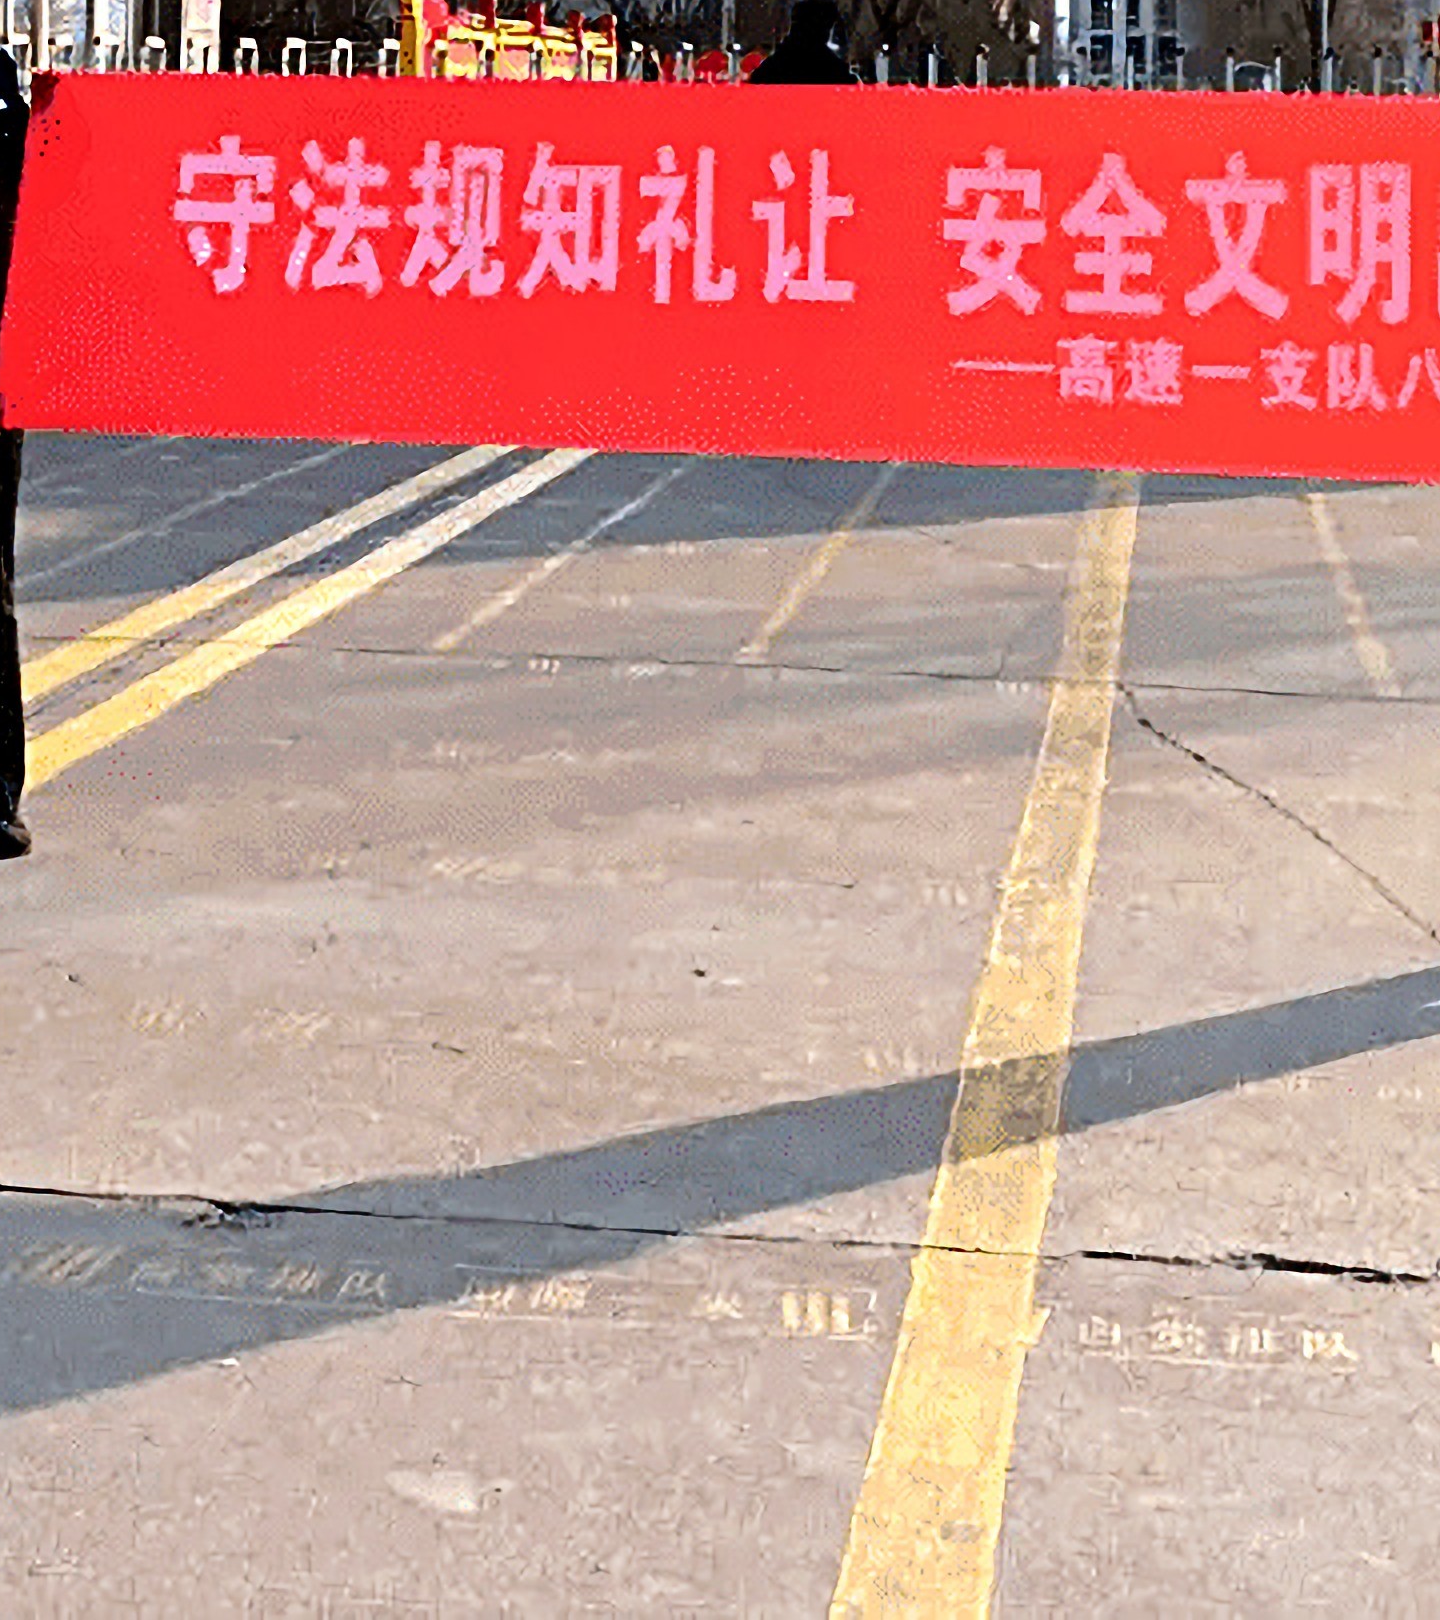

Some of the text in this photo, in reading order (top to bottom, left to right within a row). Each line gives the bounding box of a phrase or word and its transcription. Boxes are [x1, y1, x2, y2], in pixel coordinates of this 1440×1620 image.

[172, 134, 856, 305] 守法规知礼让
